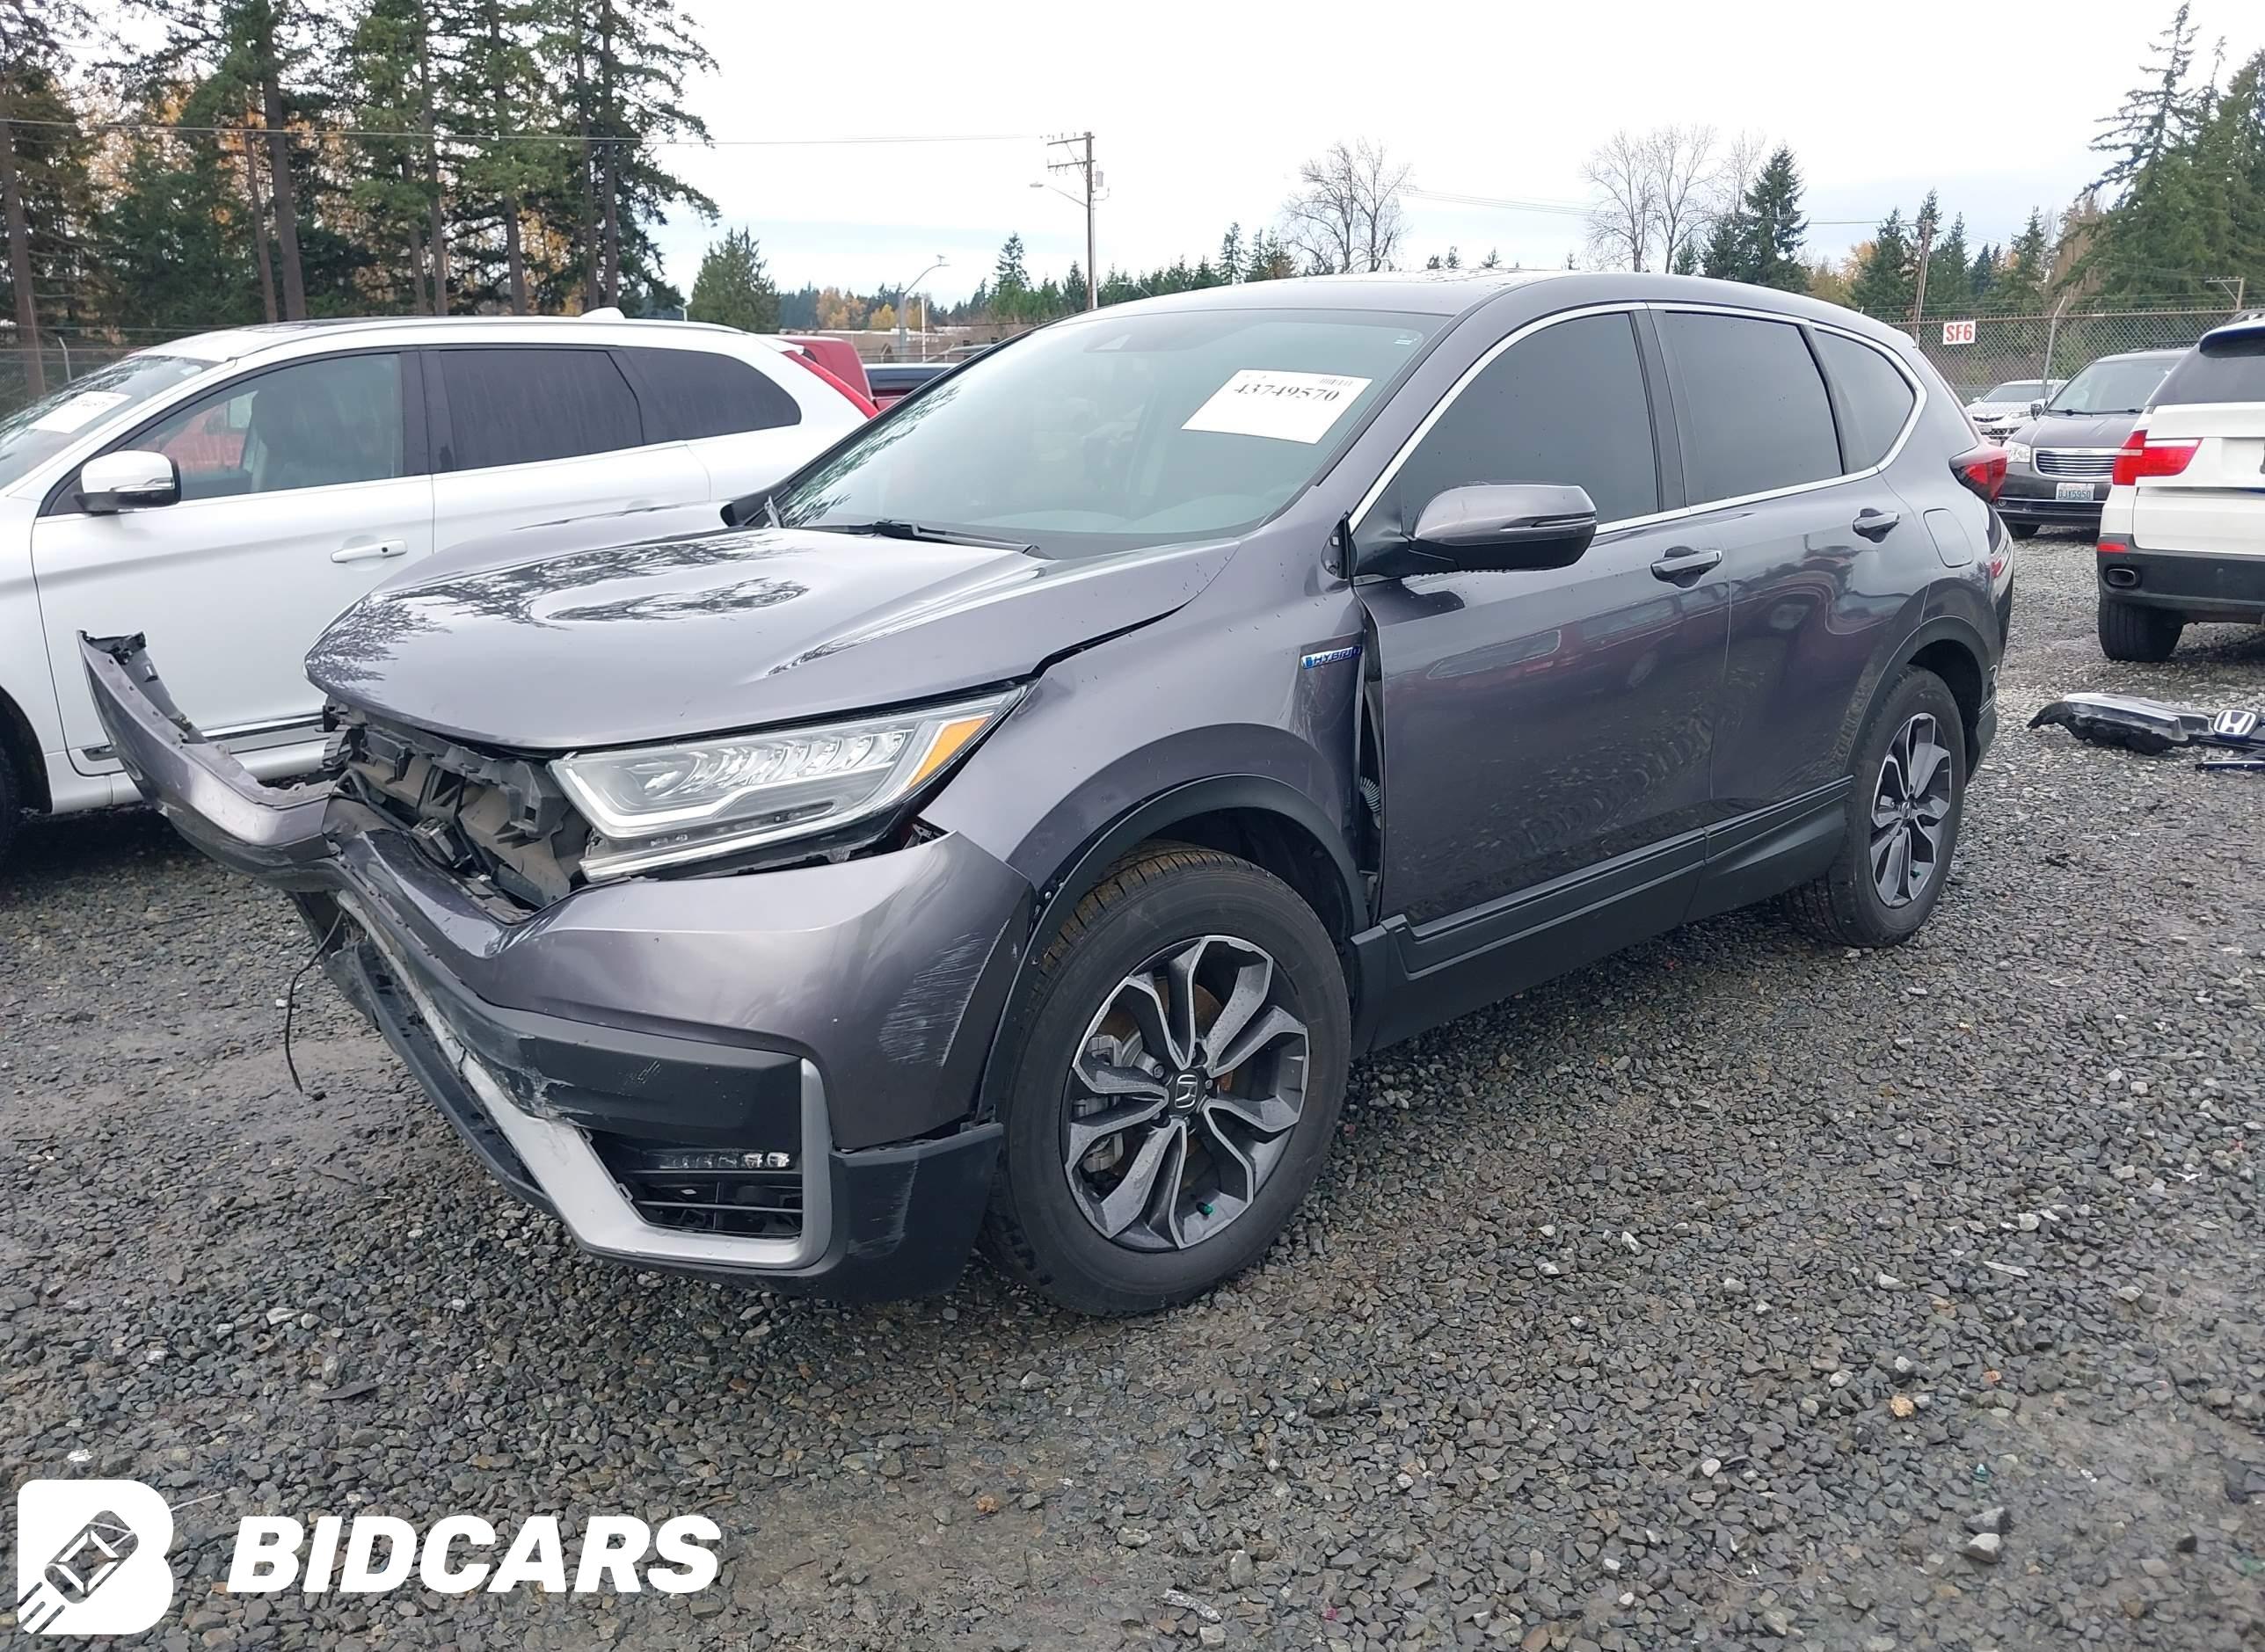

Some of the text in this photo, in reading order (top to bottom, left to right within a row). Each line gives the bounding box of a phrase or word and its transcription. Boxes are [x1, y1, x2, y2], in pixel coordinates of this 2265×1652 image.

[1946, 324, 1972, 341] SF6
[1234, 382, 1340, 402] 43749570
[1314, 646, 1361, 666] HYBRID
